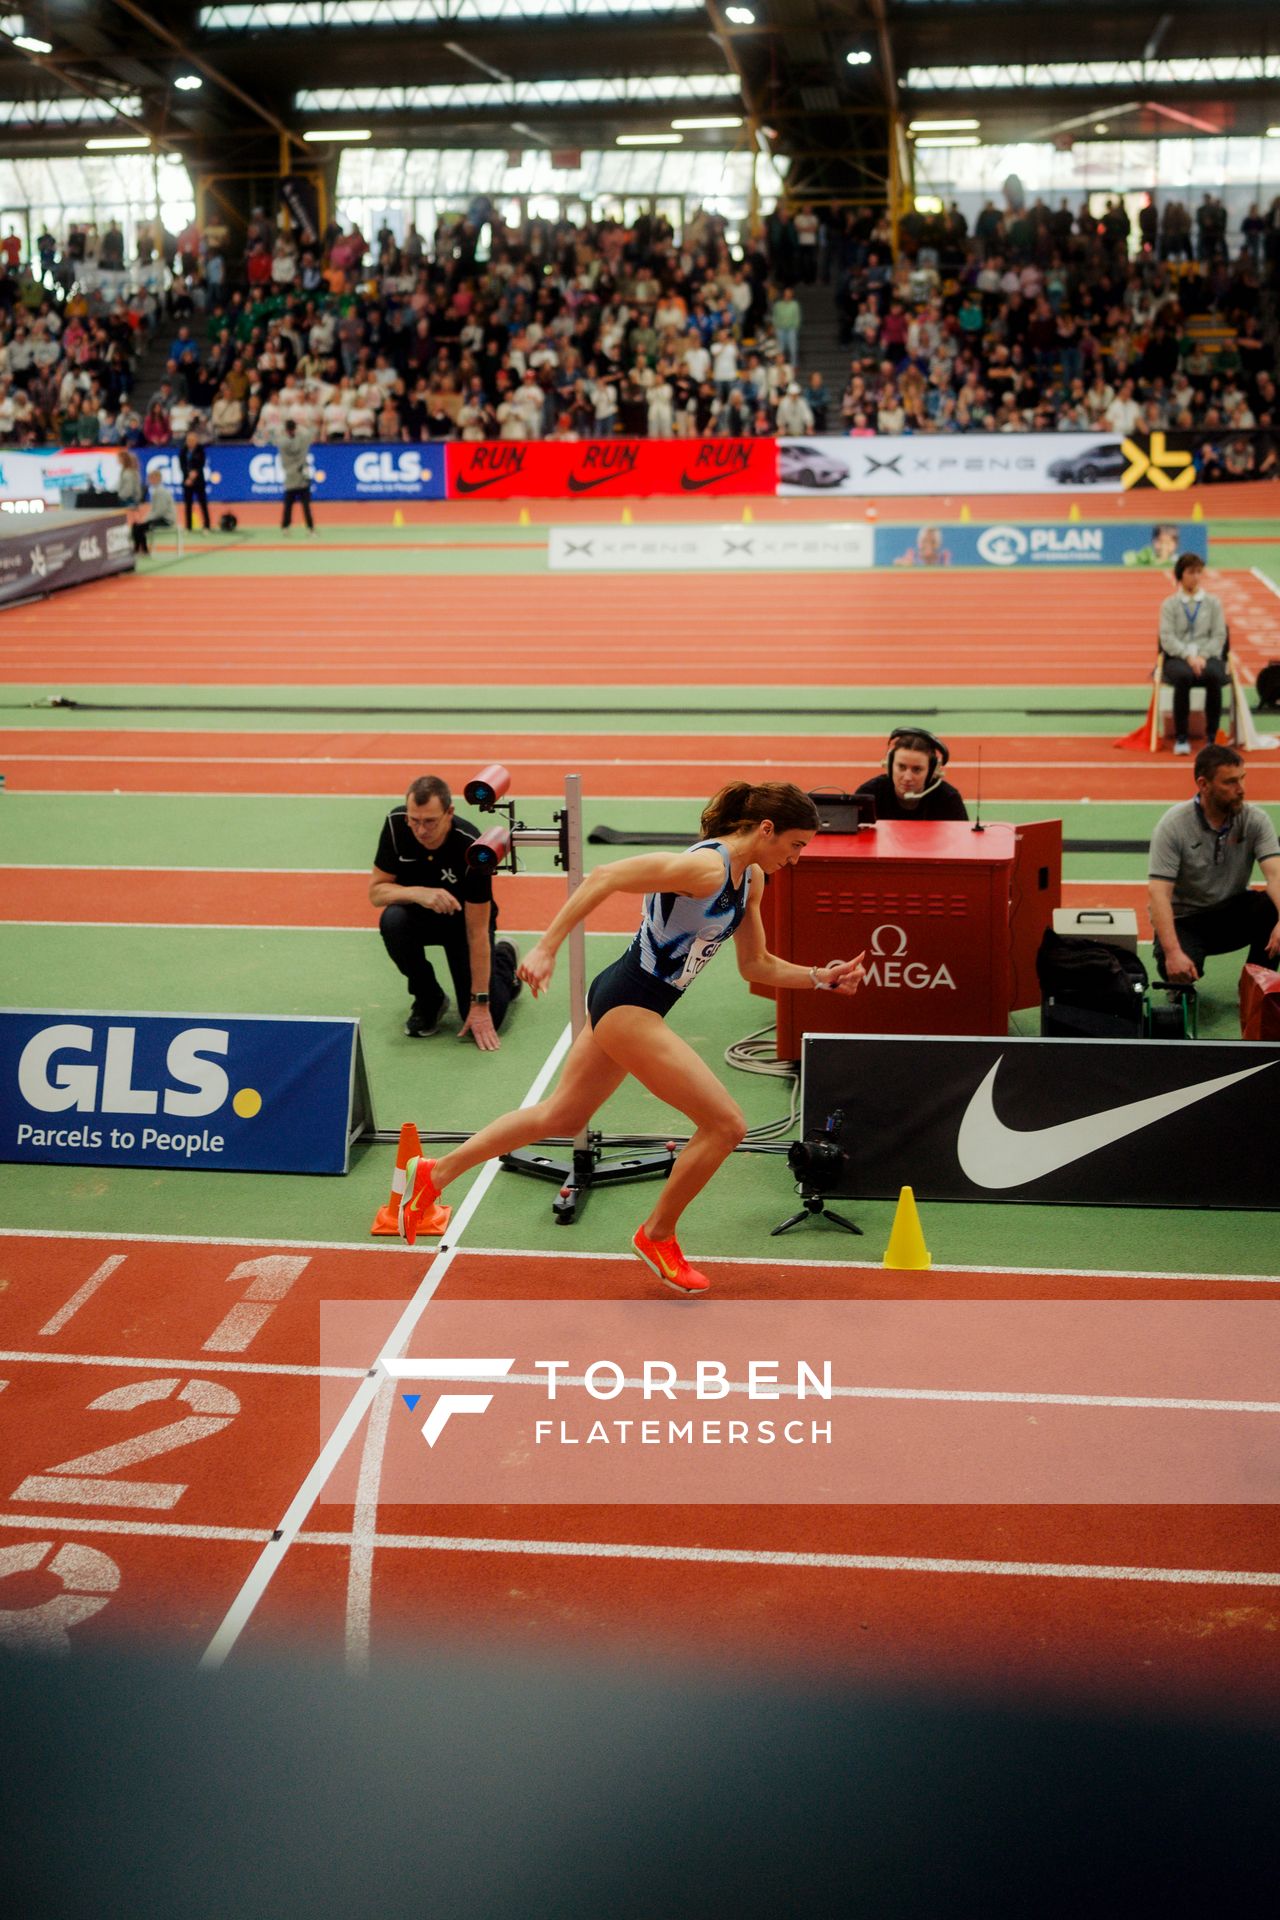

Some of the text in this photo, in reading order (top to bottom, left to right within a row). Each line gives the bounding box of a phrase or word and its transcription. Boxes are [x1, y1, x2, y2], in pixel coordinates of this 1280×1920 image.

[470, 447, 527, 470] RUN
[582, 445, 640, 469] RUN
[695, 443, 753, 468] RUN
[913, 458, 1034, 471] XPENG
[1030, 529, 1102, 550] PLAN
[17, 1124, 224, 1157] Parcels to People
[201, 1255, 312, 1352] 1
[9, 1378, 241, 1510] 2
